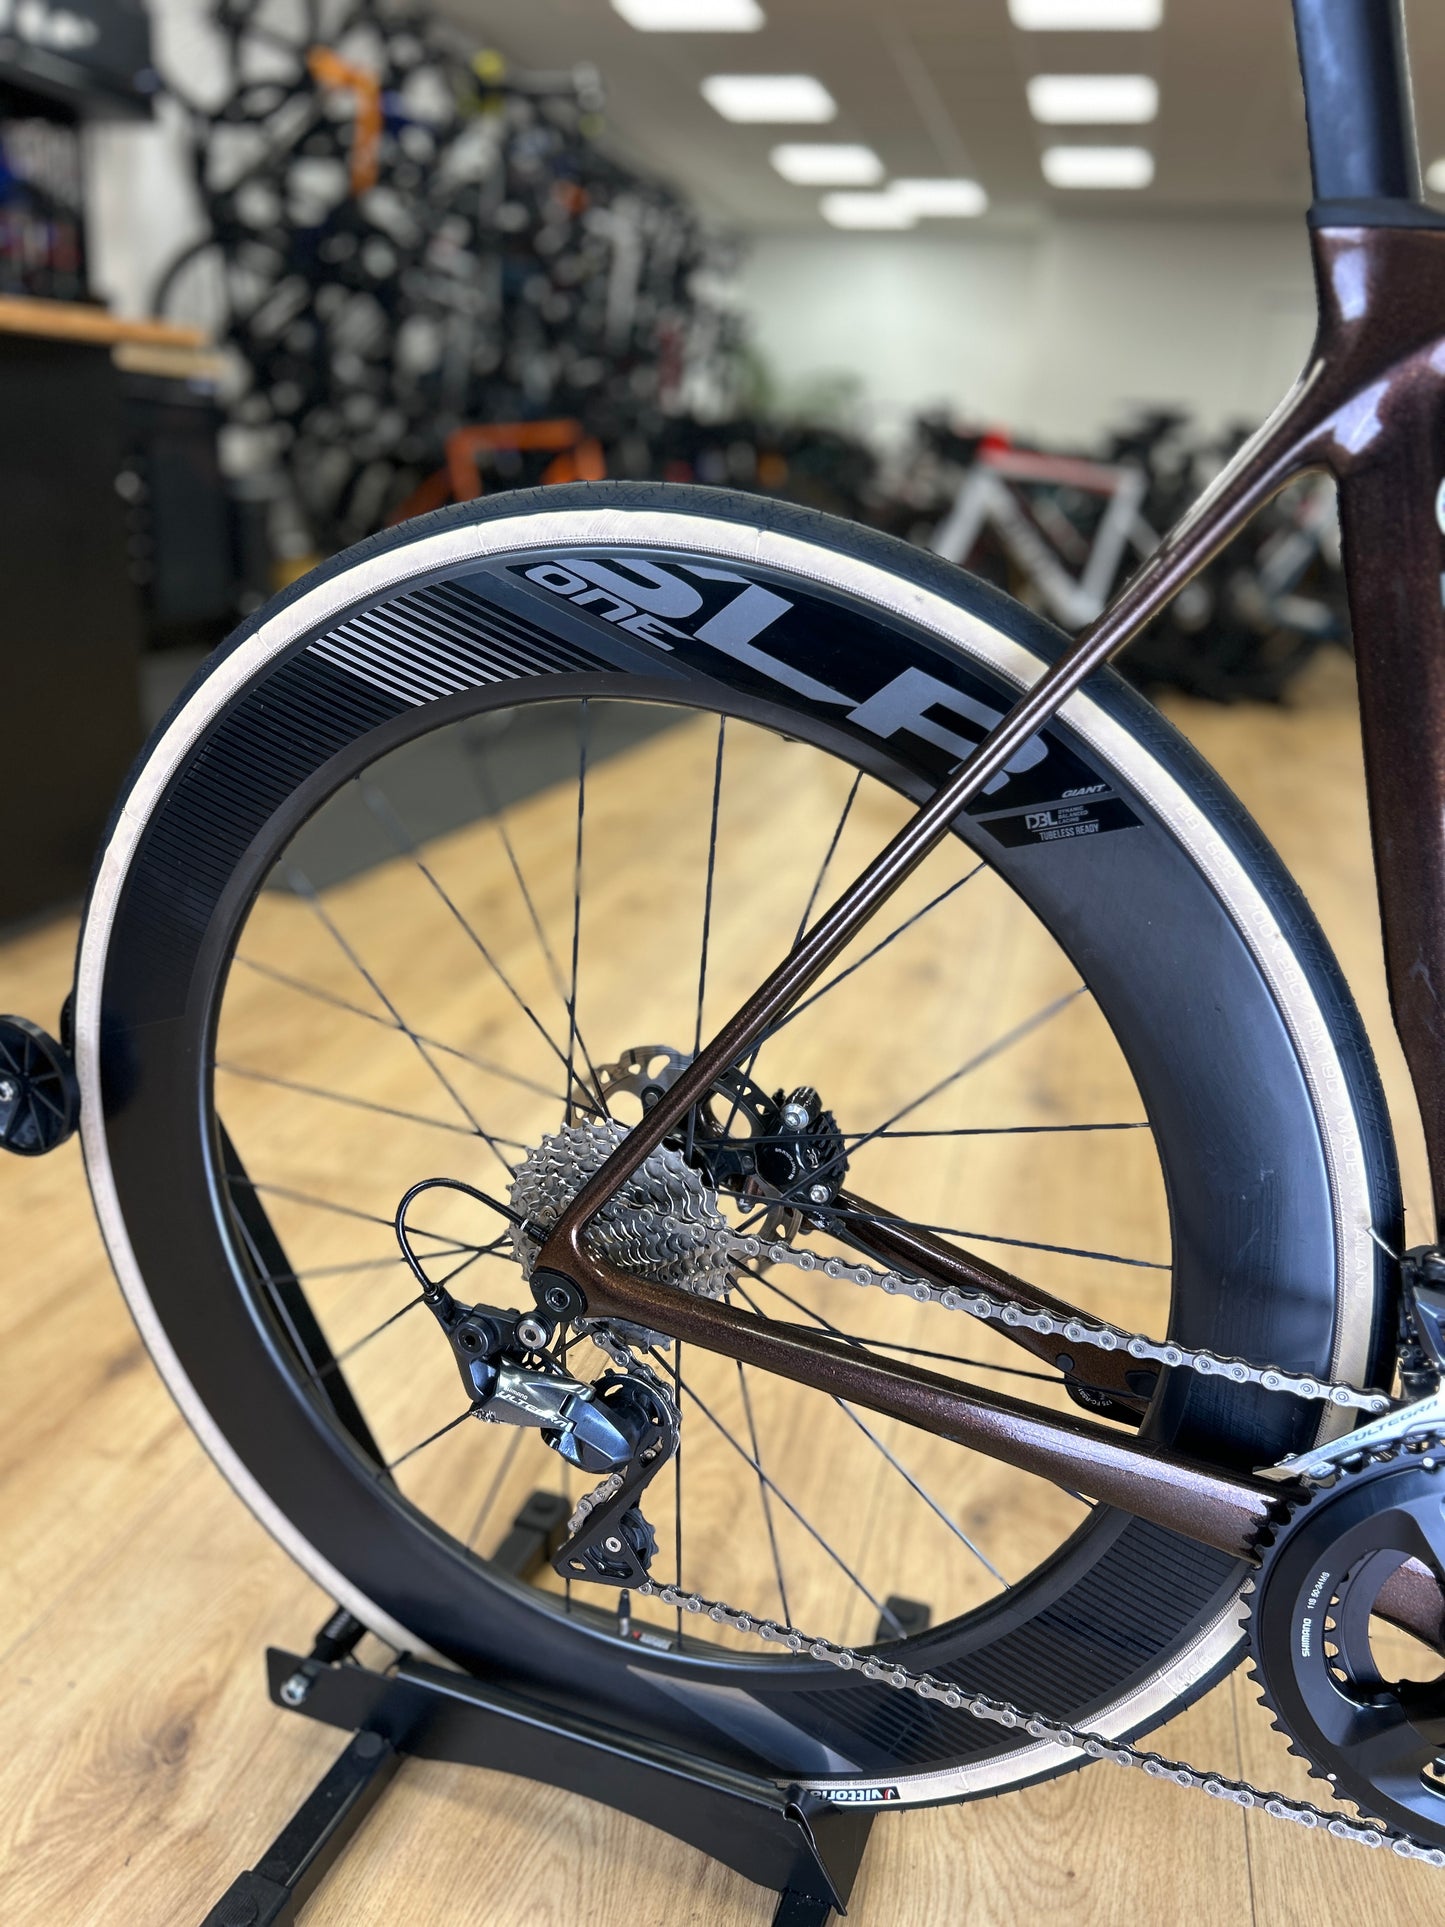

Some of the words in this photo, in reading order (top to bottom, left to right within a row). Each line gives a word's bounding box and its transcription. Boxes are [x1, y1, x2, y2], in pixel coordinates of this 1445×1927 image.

[552, 559, 1049, 795] SLR
[1061, 784, 1106, 798] GIANT
[1058, 805, 1084, 815] DYNAMIC
[1058, 809, 1089, 820] BALANCED
[1039, 827, 1075, 840] TUBELESS
[1075, 823, 1099, 836] READY
[1335, 1114, 1360, 1174] MADE
[495, 1391, 568, 1428] ULTEGRA
[1354, 1399, 1438, 1441] ULTEGRA
[1301, 1617, 1312, 1657] SHIMANO
